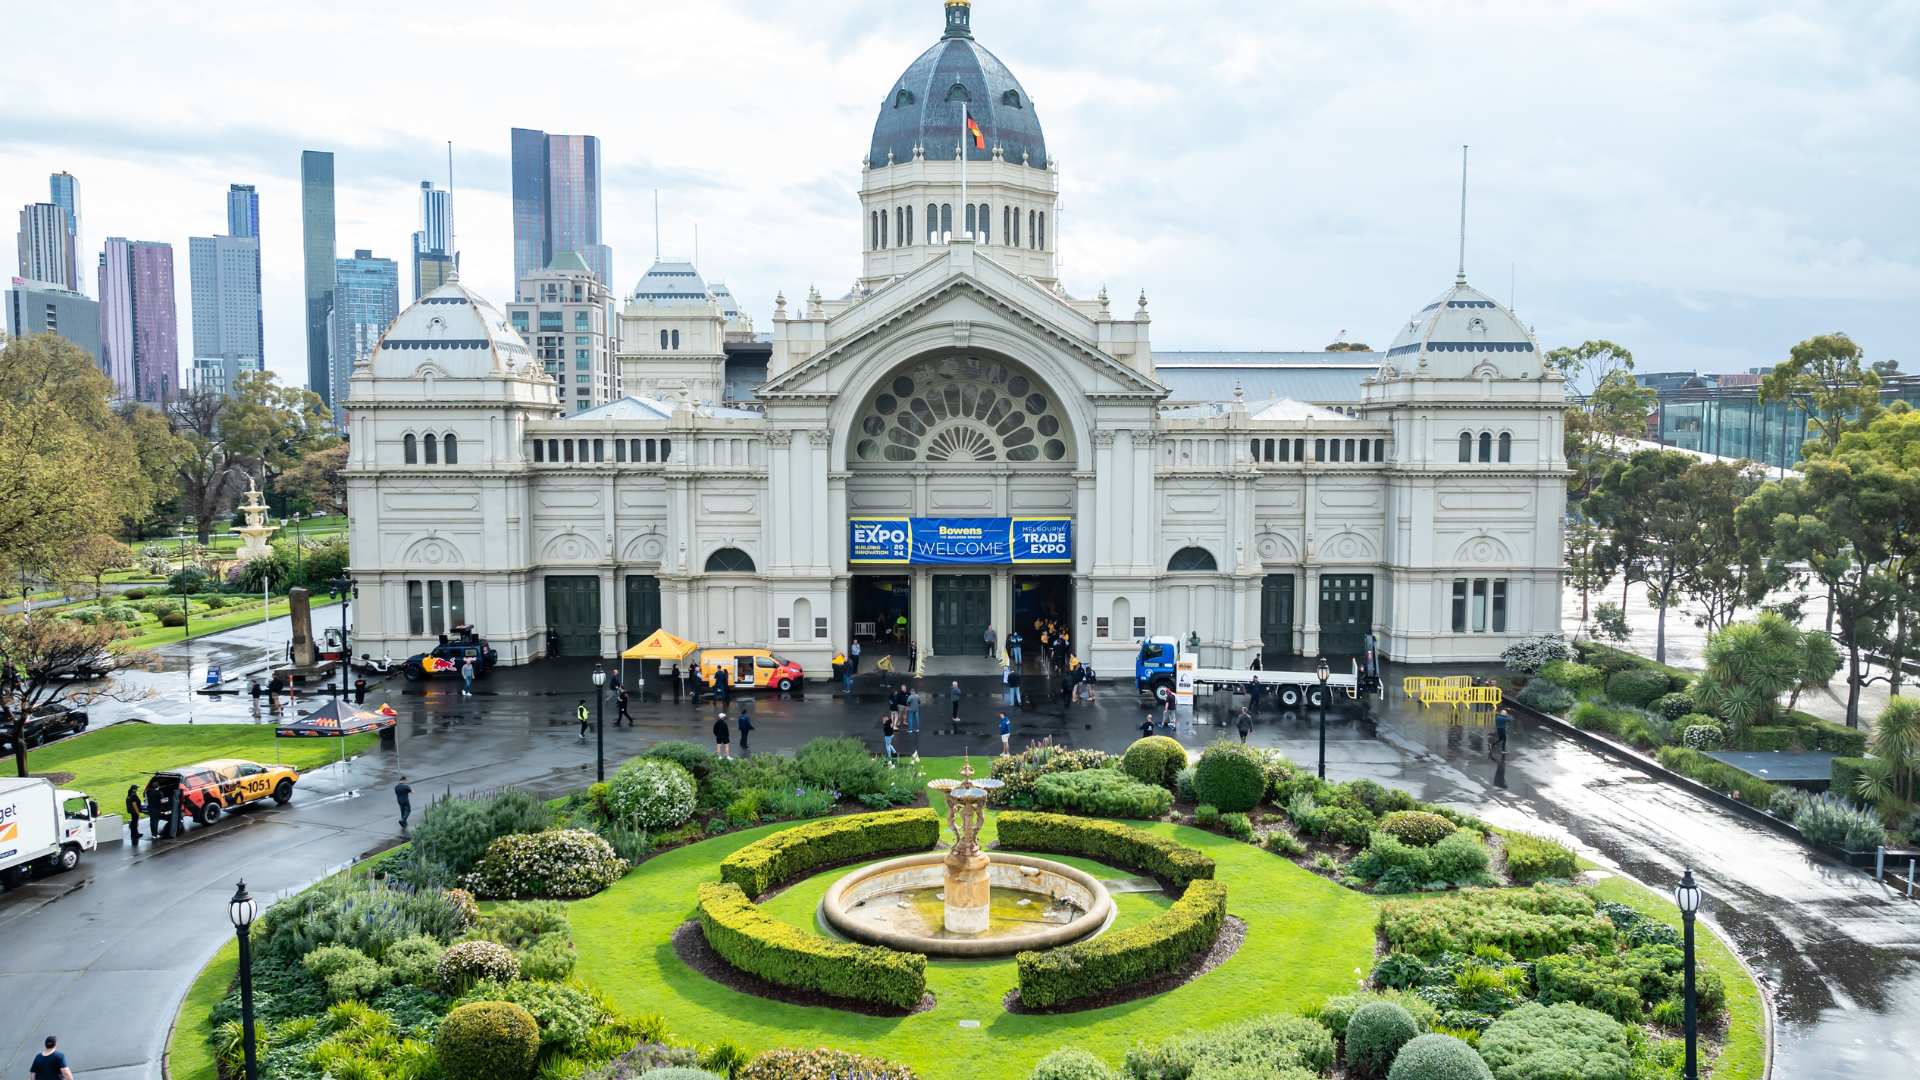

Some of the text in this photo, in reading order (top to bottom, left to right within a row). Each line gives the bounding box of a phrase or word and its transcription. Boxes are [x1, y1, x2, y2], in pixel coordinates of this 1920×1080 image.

[854, 524, 905, 543] EXPO
[939, 526, 982, 535] Bowens
[1023, 533, 1066, 543] TRADE
[918, 542, 1004, 555] WELCOME
[1031, 544, 1066, 554] EXPO
